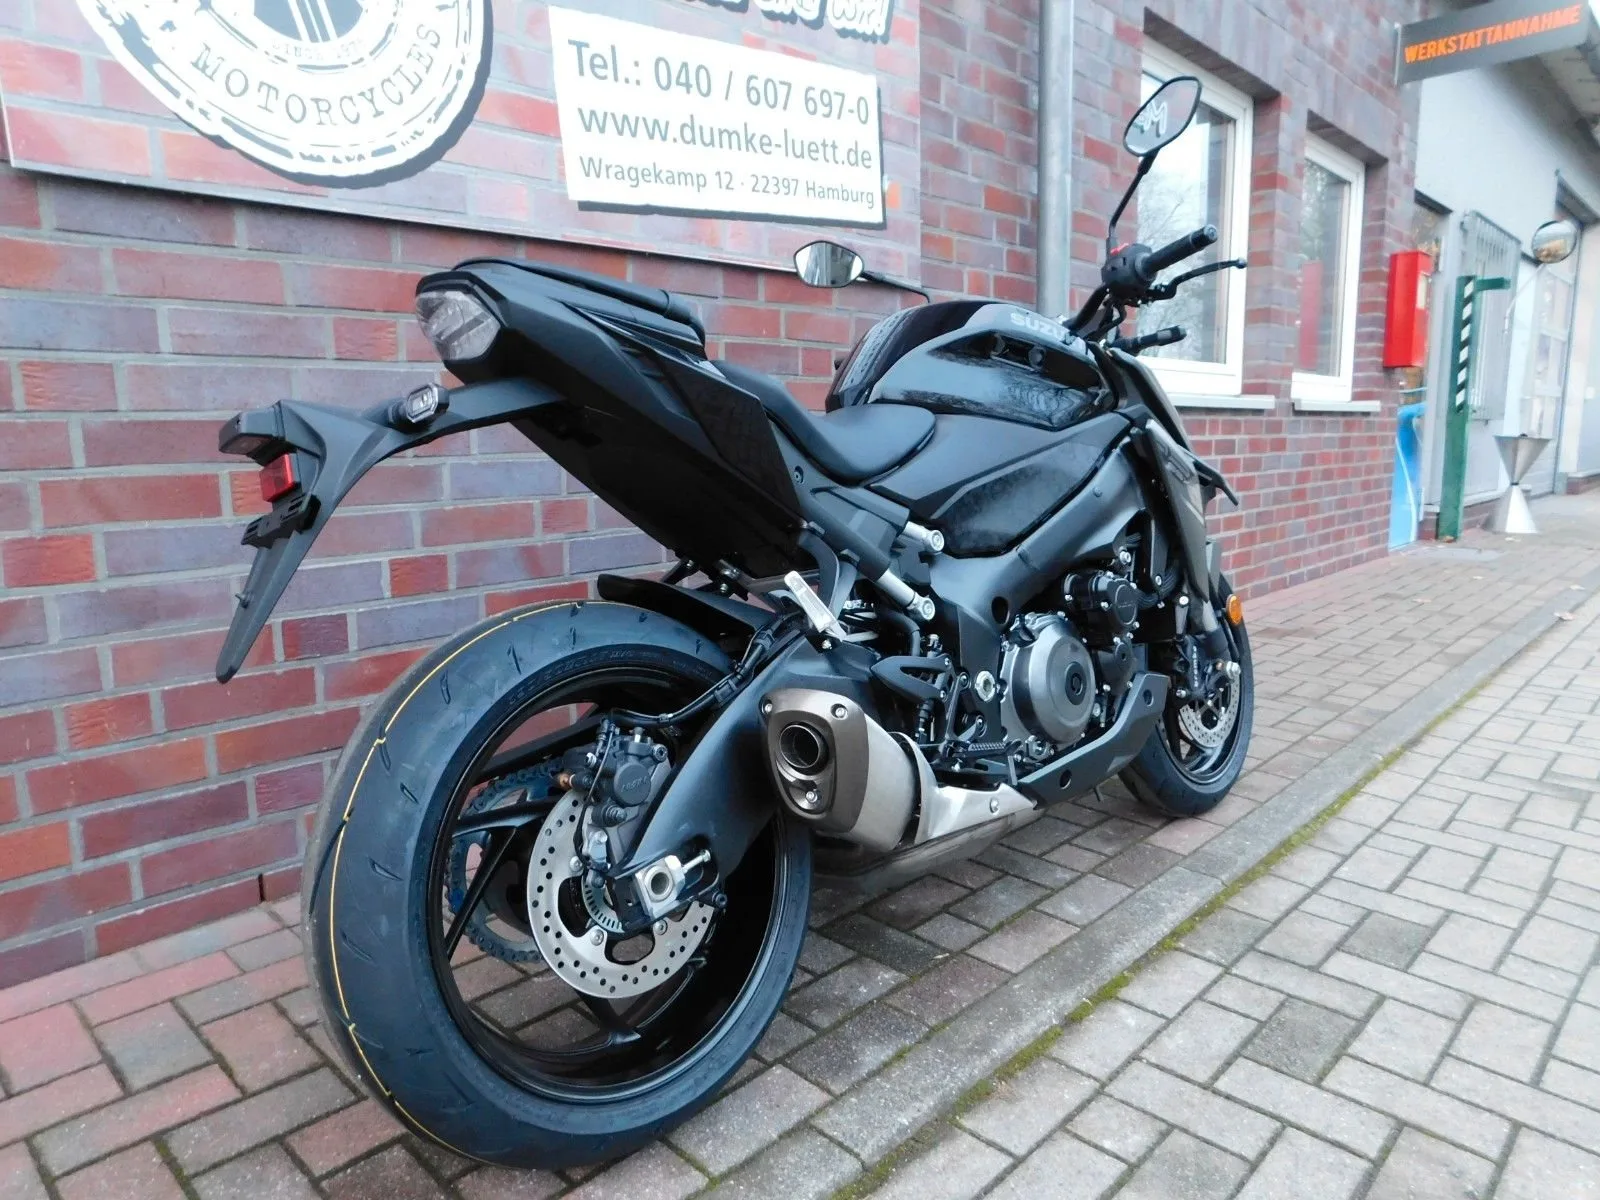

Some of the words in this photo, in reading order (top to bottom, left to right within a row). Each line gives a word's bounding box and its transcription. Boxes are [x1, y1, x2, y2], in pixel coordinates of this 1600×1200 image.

[1404, 4, 1582, 64] WERKSTATTANNAHME
[190, 23, 441, 126] MOTORCYCLES
[568, 39, 642, 86] Tel.:
[654, 56, 712, 98] 040
[746, 74, 792, 111] 607
[804, 86, 869, 125] 697-0
[577, 107, 872, 169] www.dumke-luett.de
[579, 155, 707, 193] Wragekamp
[715, 171, 735, 190] 12
[751, 174, 799, 197] 22397
[805, 180, 875, 209] Hamburg
[1010, 312, 1066, 342] SUZU
